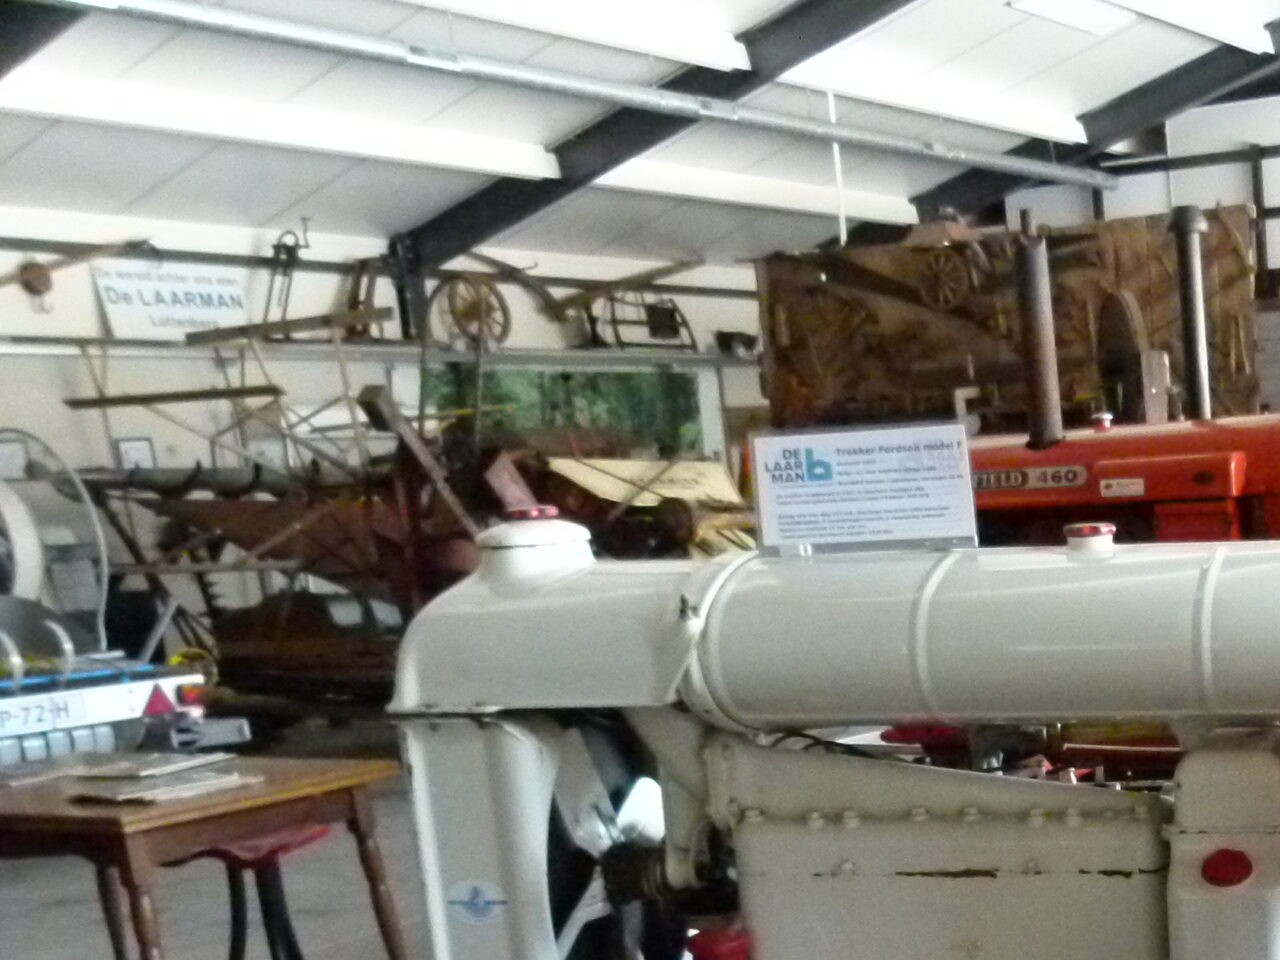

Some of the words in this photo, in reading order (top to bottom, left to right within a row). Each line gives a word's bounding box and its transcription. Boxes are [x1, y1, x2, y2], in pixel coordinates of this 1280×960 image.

[104, 287, 134, 305] De
[136, 289, 244, 309] LAARMAN
[782, 449, 801, 460] DE
[878, 444, 921, 454] Fordson
[765, 460, 803, 473] LAAR
[771, 471, 806, 483] MAN
[1036, 468, 1078, 485] 460
